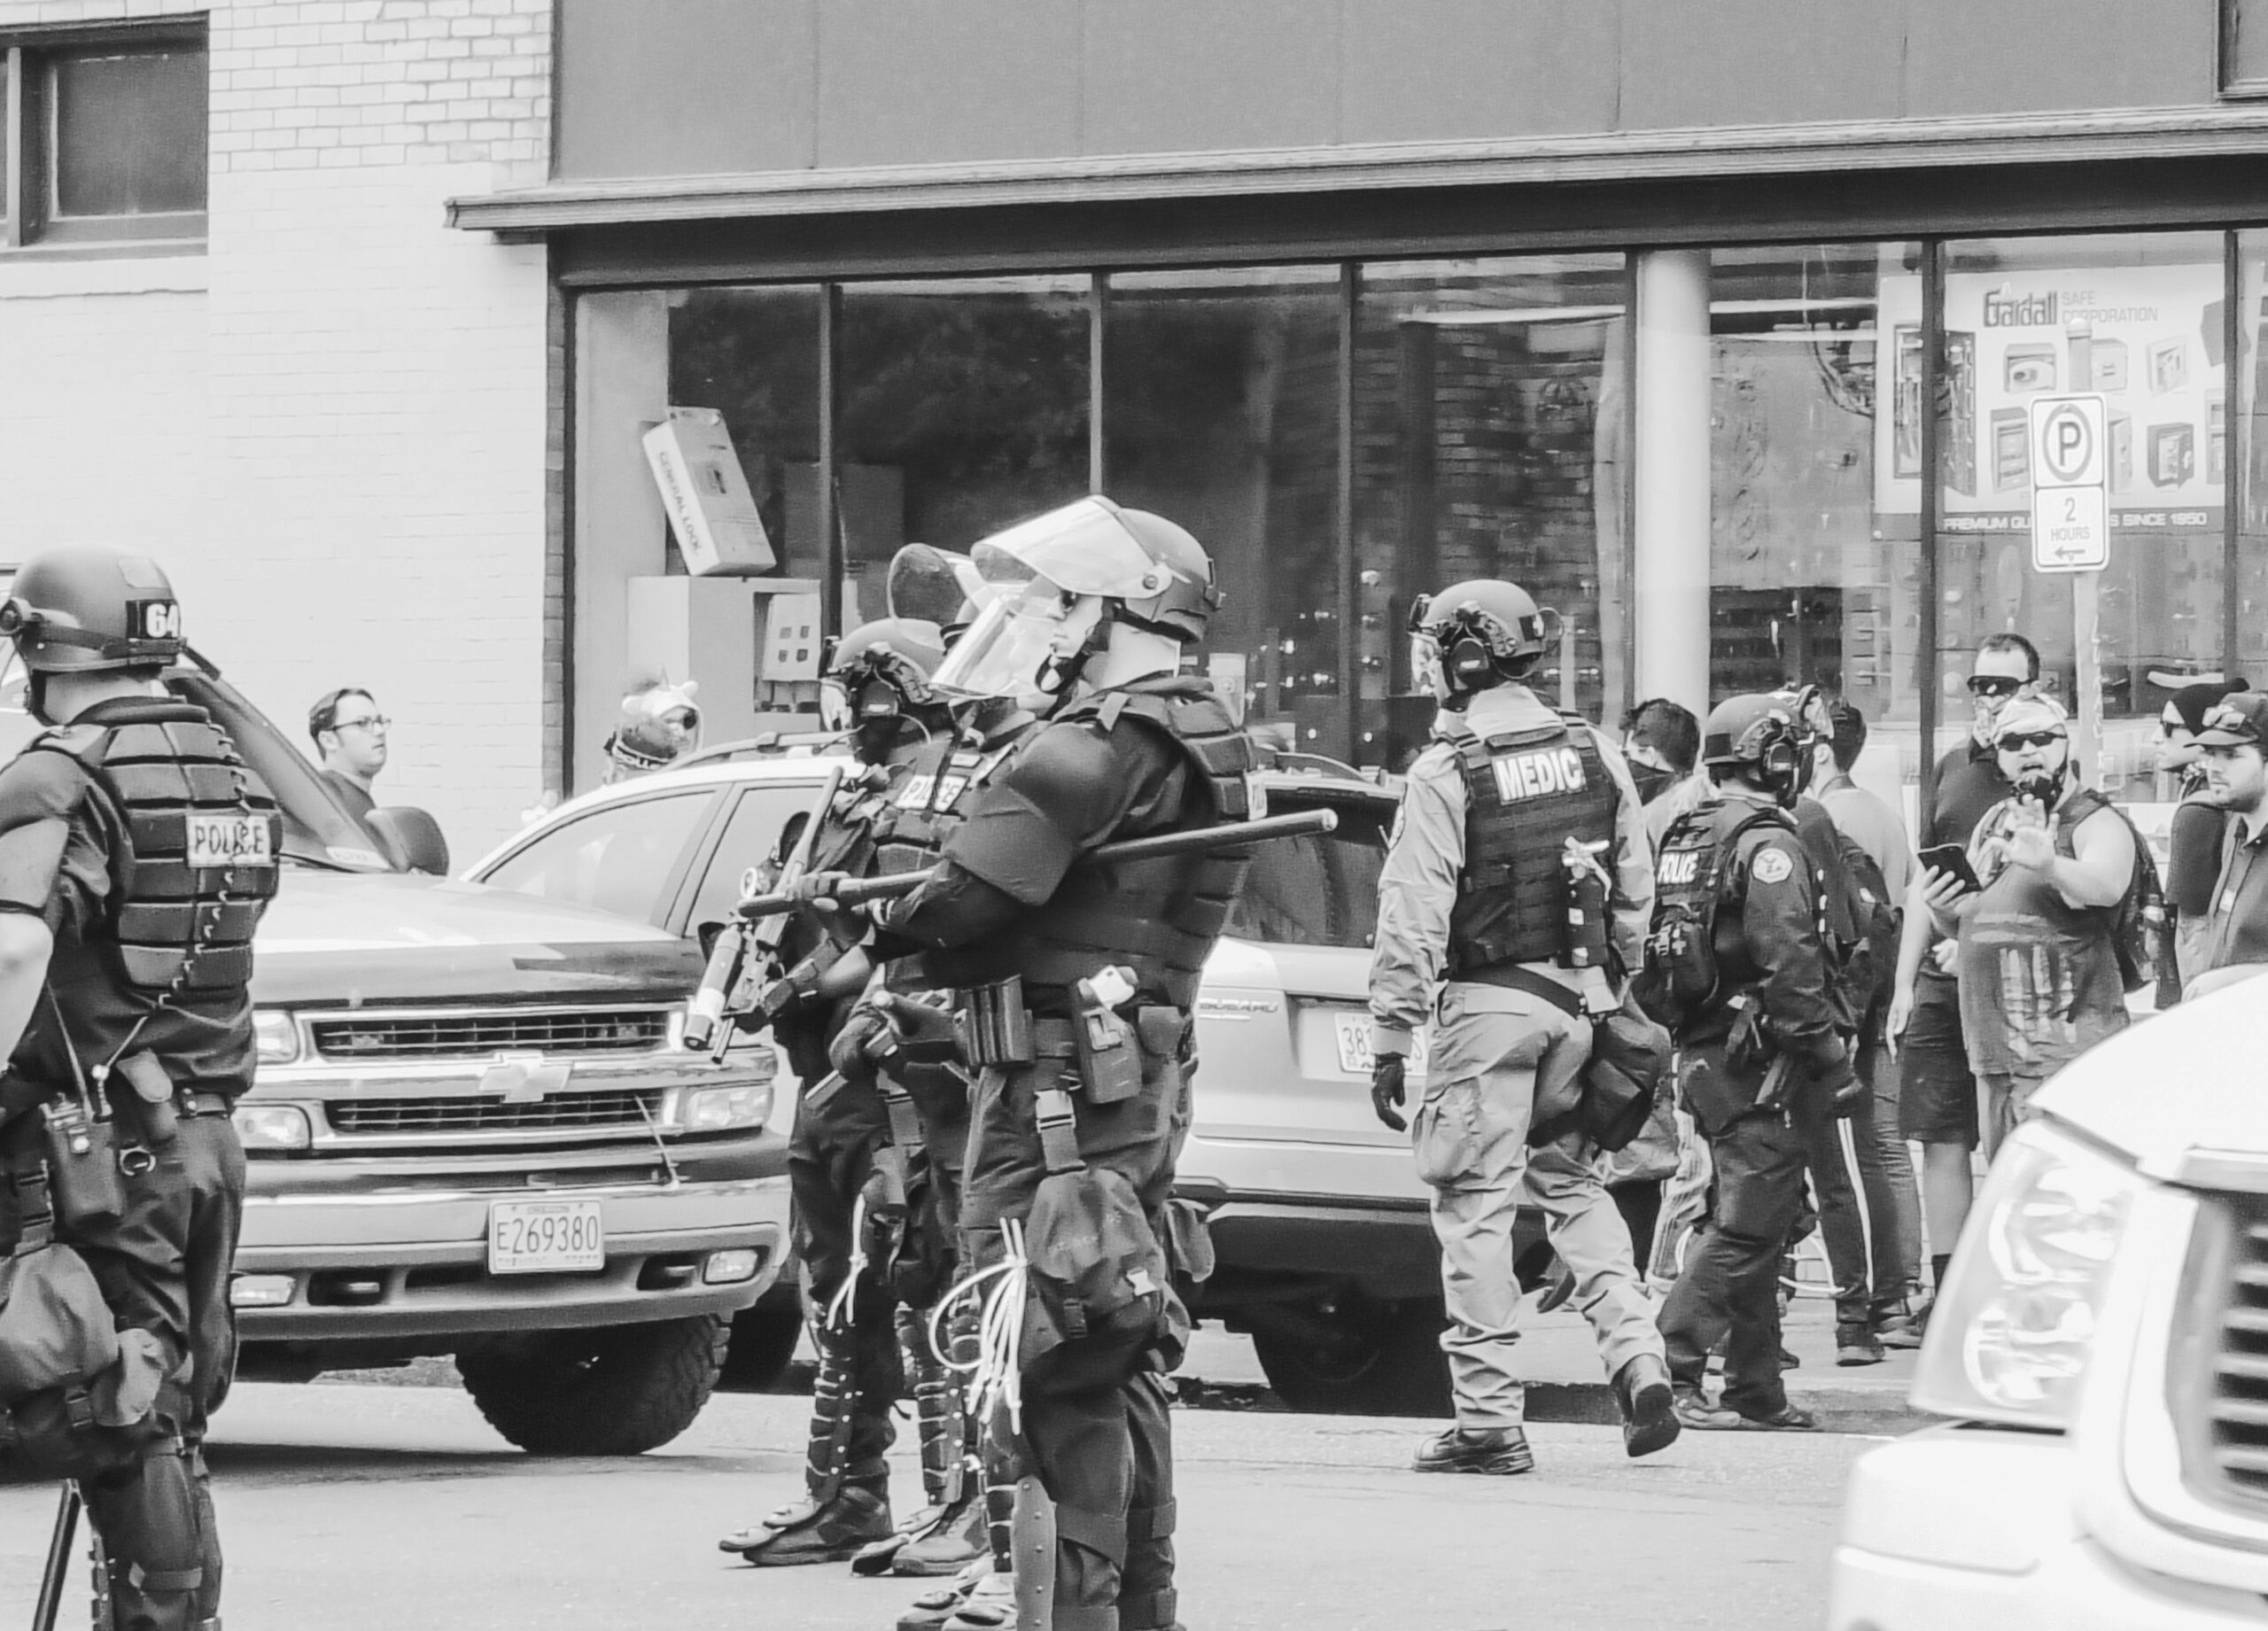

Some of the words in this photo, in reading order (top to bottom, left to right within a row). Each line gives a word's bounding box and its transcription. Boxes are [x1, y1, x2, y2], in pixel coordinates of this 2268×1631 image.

[1984, 288, 2057, 328] Gardall
[2061, 291, 2095, 307] SAFE
[2058, 421, 2081, 467] P
[2064, 496, 2078, 523] 2
[2123, 513, 2167, 527] SINCE
[2170, 511, 2208, 525] 1950
[1944, 516, 2008, 531] PREMIUM
[2050, 526, 2091, 542] HOURS
[1495, 747, 1582, 802] MEDIC
[497, 1215, 599, 1254] E269380
